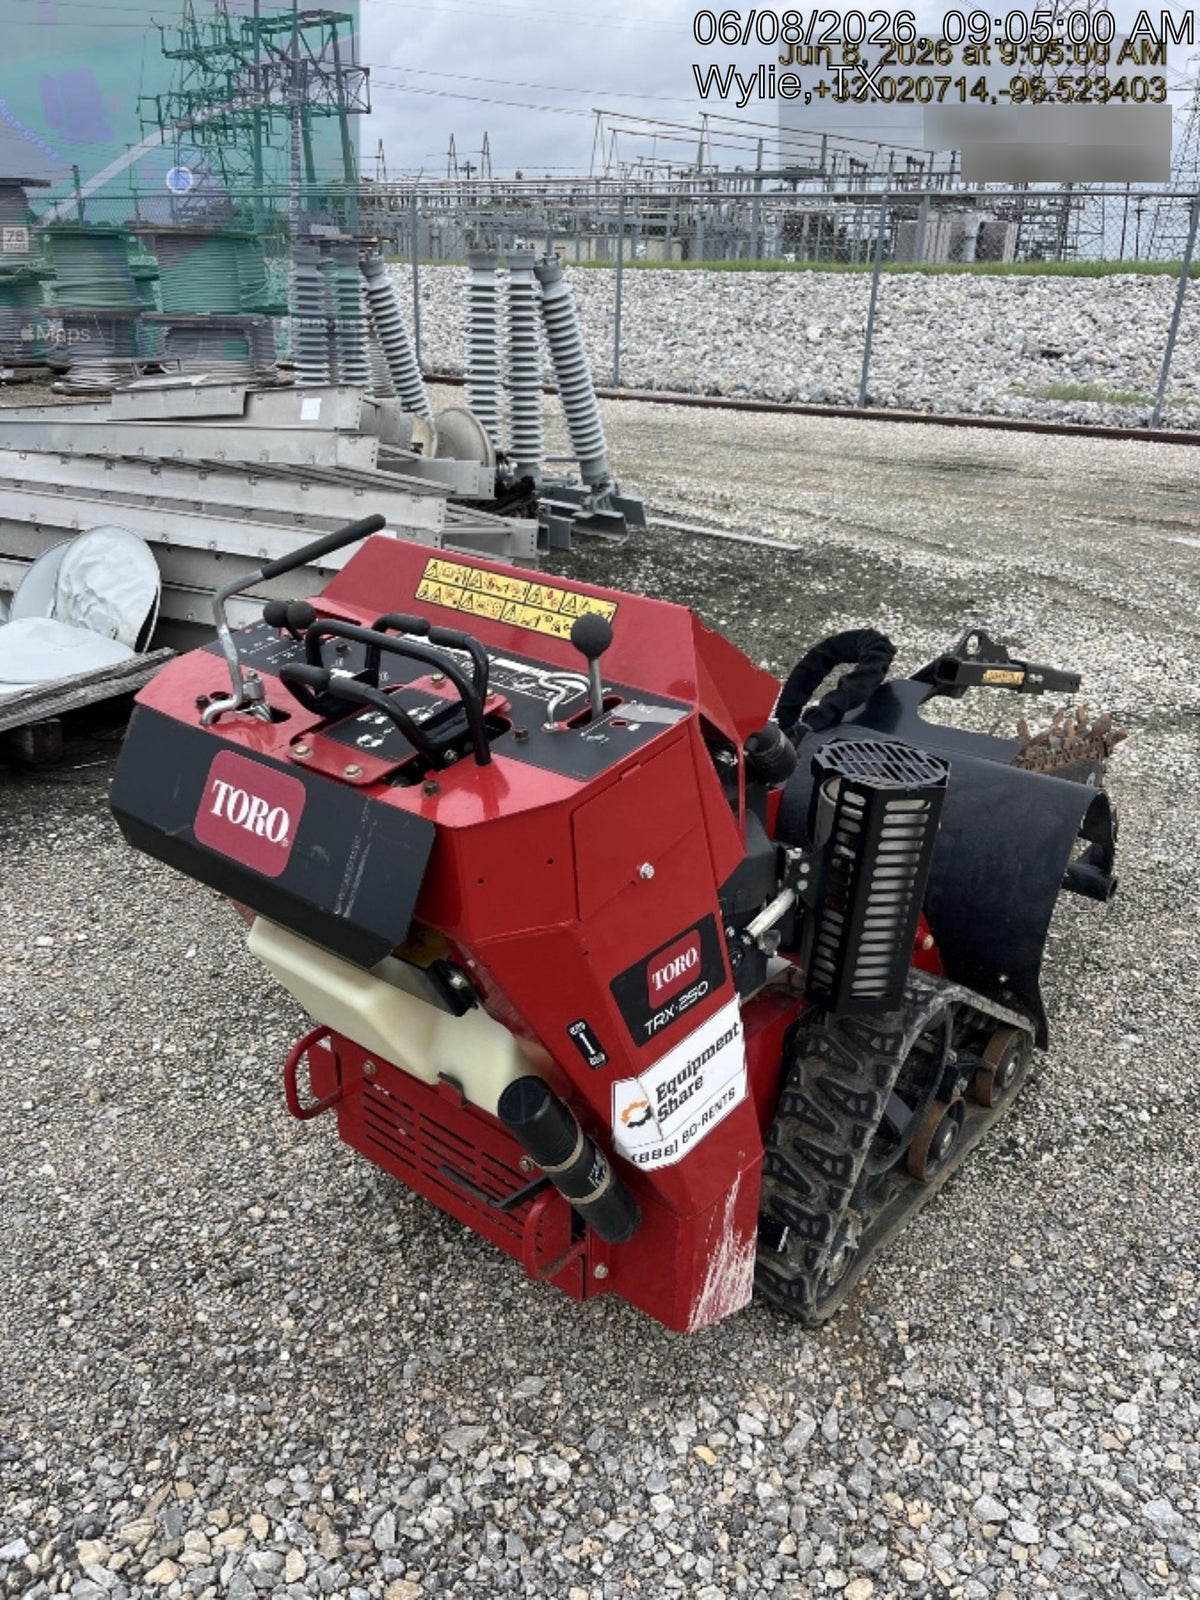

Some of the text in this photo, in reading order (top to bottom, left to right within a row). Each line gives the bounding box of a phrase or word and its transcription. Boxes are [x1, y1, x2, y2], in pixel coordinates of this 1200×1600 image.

[209, 778, 290, 846] TORO
[651, 946, 699, 992] TORO
[655, 1020, 741, 1105] Equipment
[657, 1074, 704, 1124] Share
